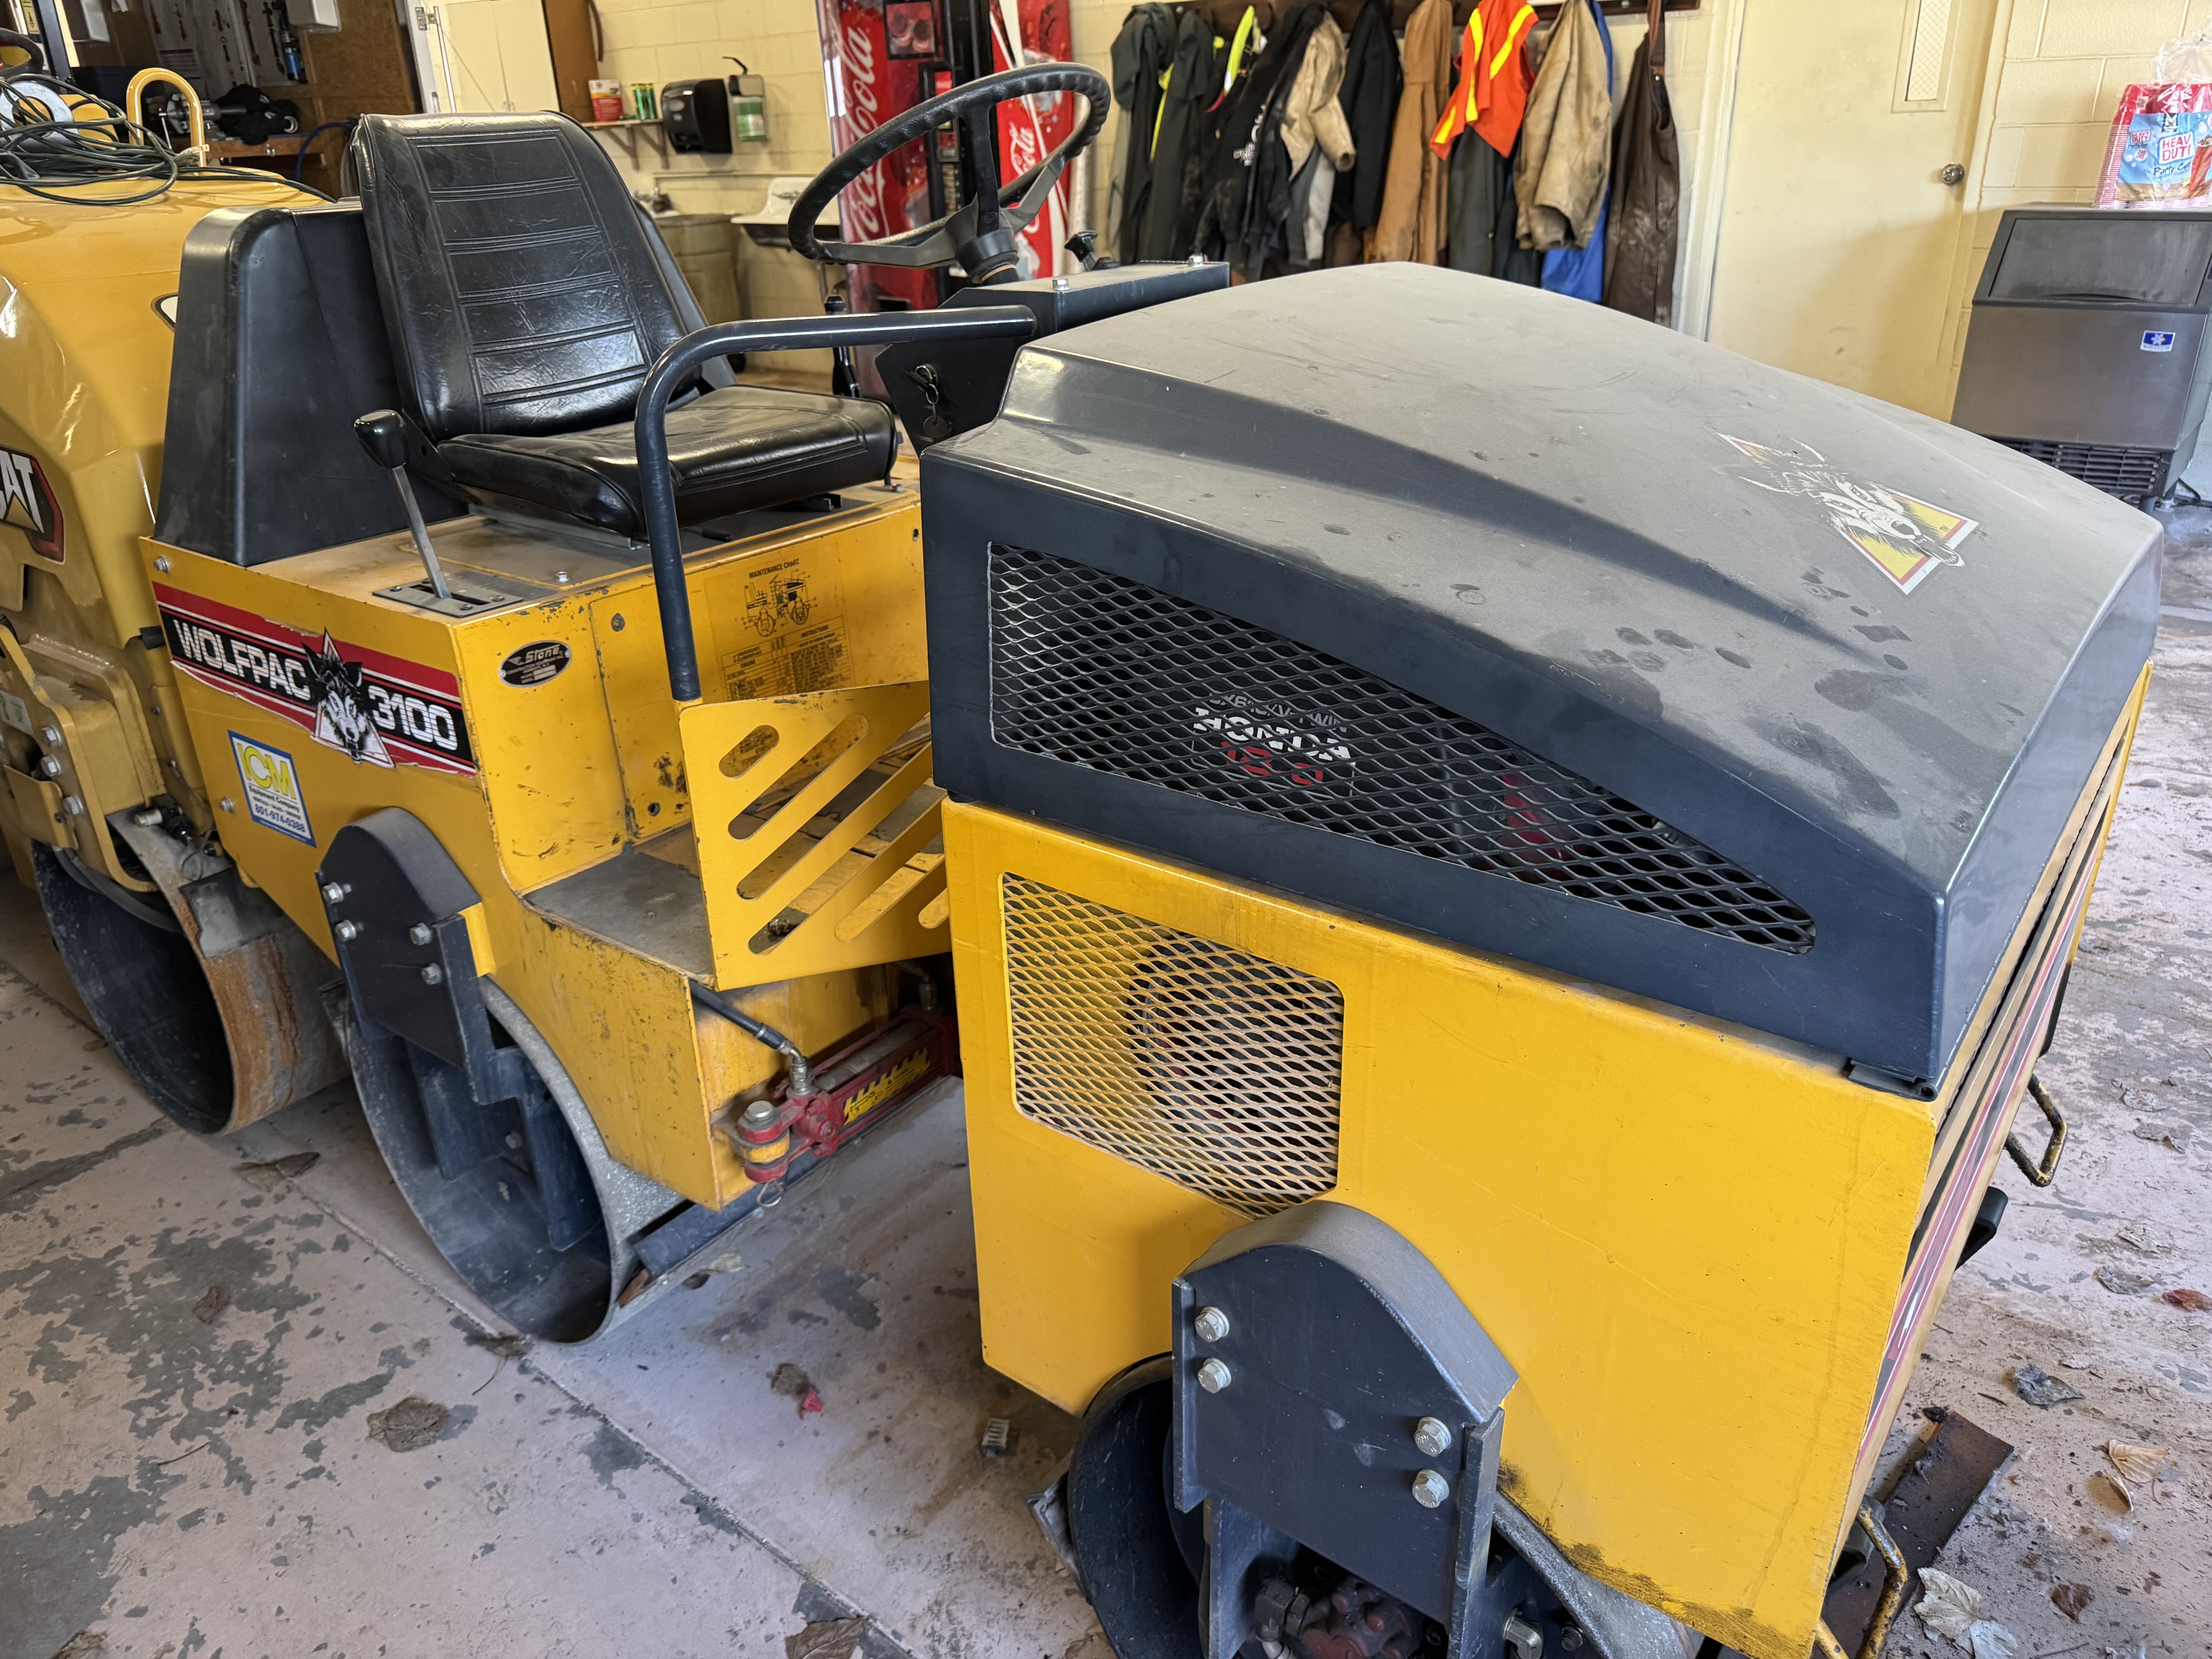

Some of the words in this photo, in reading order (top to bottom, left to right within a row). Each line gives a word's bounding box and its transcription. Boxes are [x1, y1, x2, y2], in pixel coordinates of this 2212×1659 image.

[2162, 134, 2191, 149] HEAV
[0, 449, 45, 533] AT
[749, 564, 783, 579] MAINTENANCE
[784, 558, 799, 569] CHART
[526, 644, 561, 662] Stone
[173, 619, 311, 701] WOLFPAC
[368, 685, 458, 751] 3100
[237, 742, 297, 800] ICM
